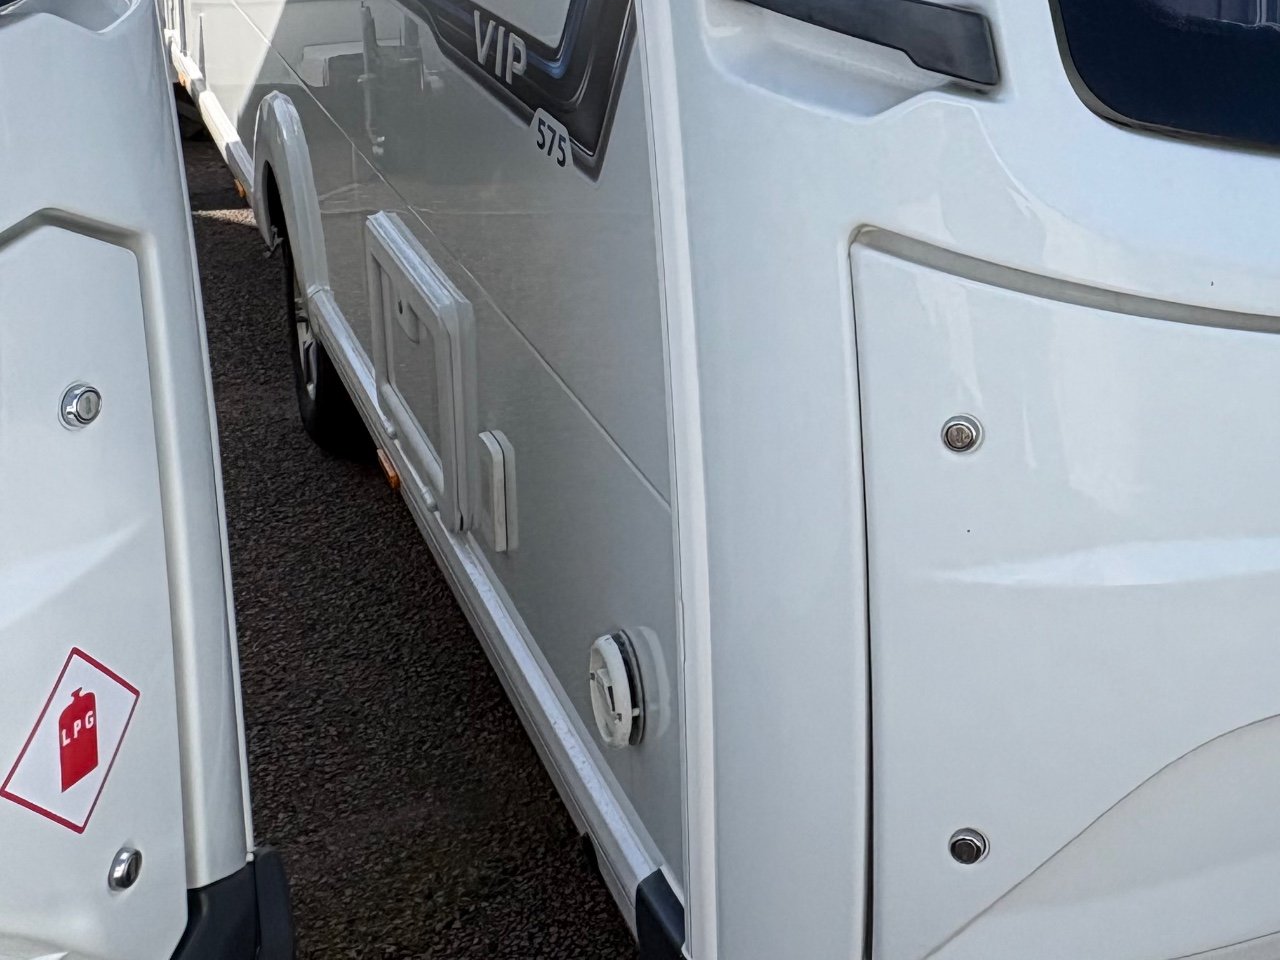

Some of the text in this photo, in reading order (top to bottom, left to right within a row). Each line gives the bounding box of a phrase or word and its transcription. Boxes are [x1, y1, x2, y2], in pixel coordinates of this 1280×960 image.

[473, 10, 528, 85] VIP
[536, 118, 567, 168] 575
[61, 710, 95, 747] LPG
